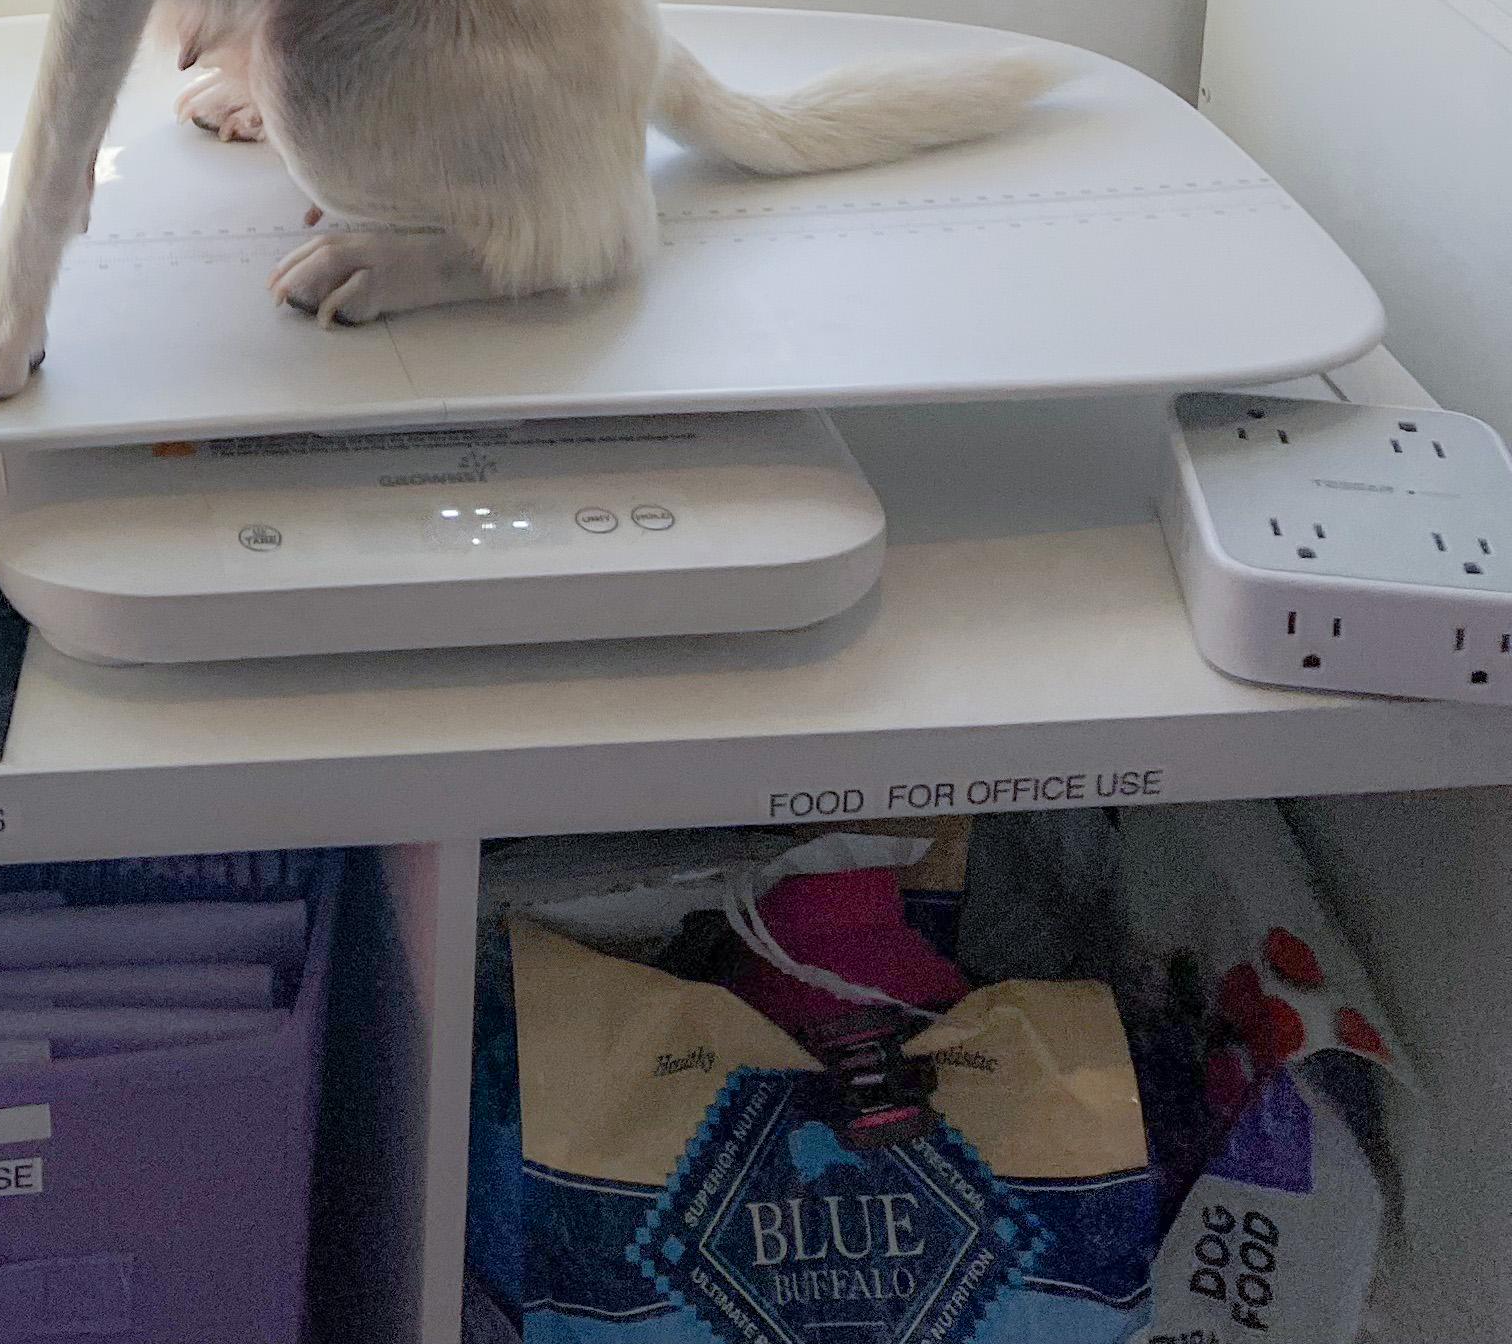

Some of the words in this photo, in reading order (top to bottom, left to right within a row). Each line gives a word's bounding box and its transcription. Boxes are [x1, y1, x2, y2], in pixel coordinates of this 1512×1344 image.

[768, 789, 864, 818] FOOD
[888, 782, 955, 810] FOR
[967, 774, 1087, 805] OFFICE
[1096, 768, 1165, 797] USE
[684, 1140, 740, 1228] SUPERIOR
[745, 1192, 927, 1266] BLUE
[1189, 1204, 1237, 1302] DOG
[1231, 1210, 1280, 1332] FOOD
[773, 1266, 917, 1305] BUFFALO
[928, 1247, 996, 1342] NUTRITION
